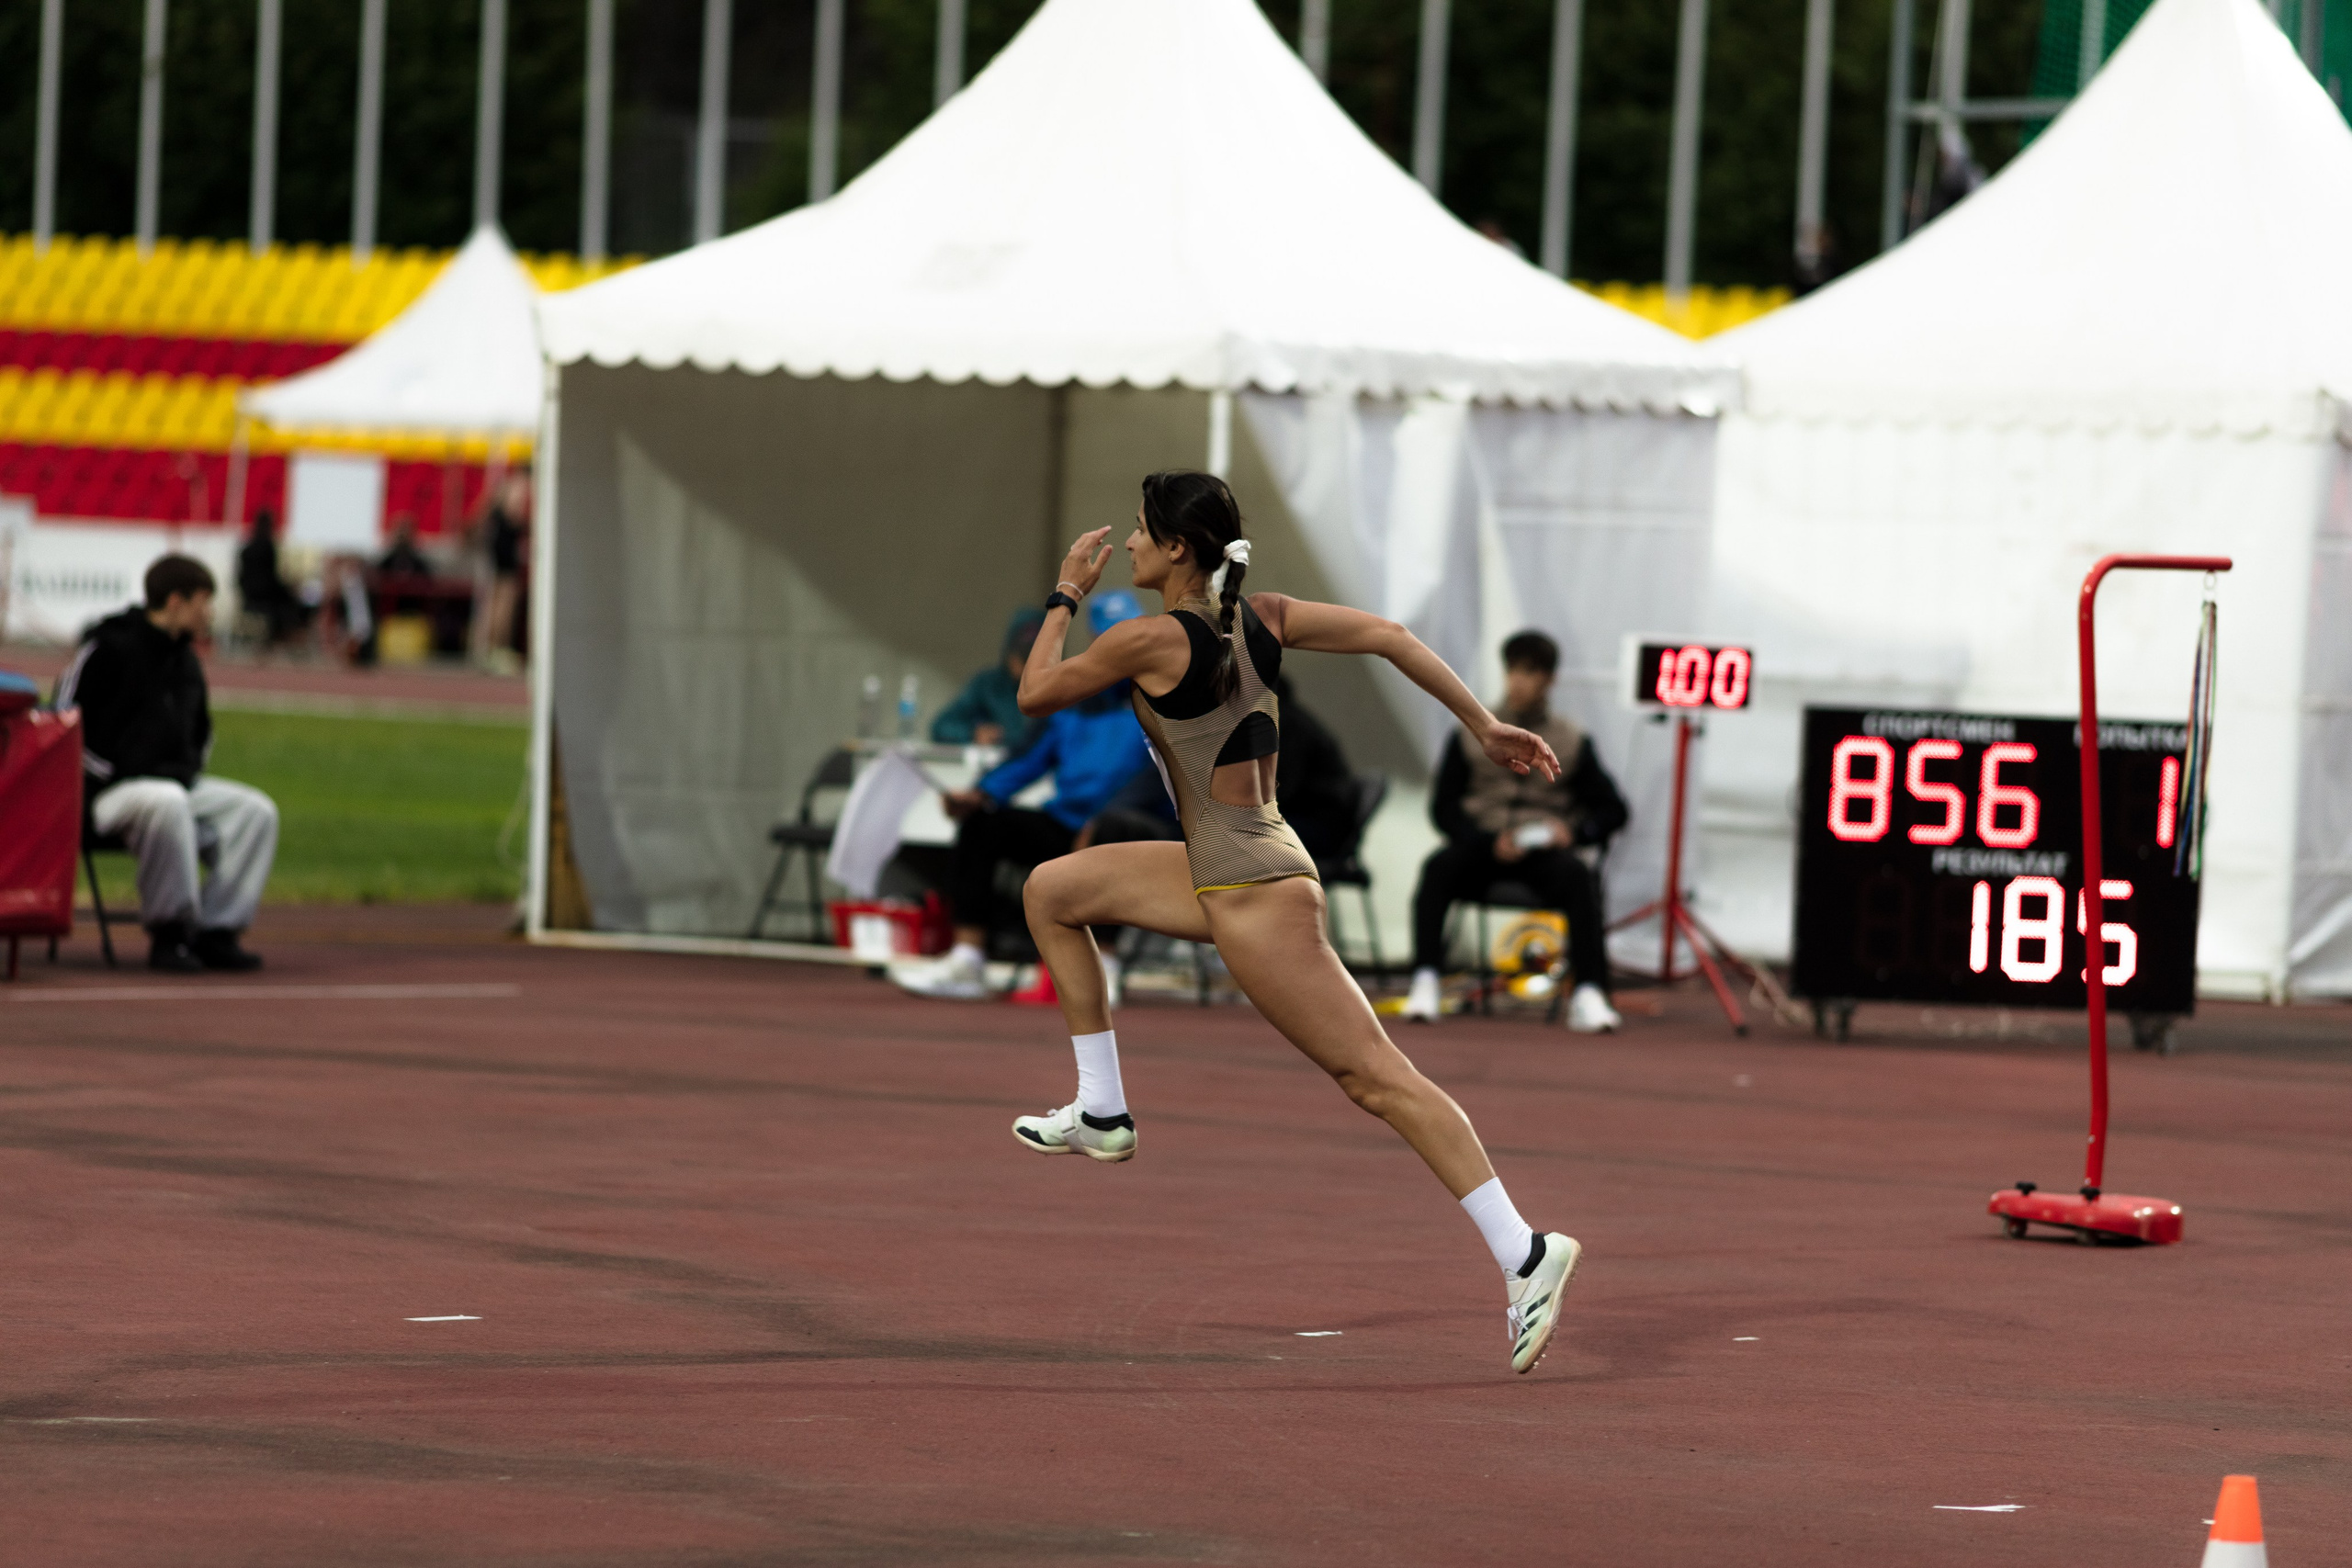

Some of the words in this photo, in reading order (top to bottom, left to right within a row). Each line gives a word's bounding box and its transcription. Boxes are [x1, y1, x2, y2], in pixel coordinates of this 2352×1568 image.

[1862, 714, 2015, 743] СПОРТСМЕН
[1827, 735, 2041, 849] 856
[2155, 755, 2180, 849] 1
[1932, 847, 2069, 877] РЕЗУЛЬТАТ
[1970, 875, 2138, 986] 185
